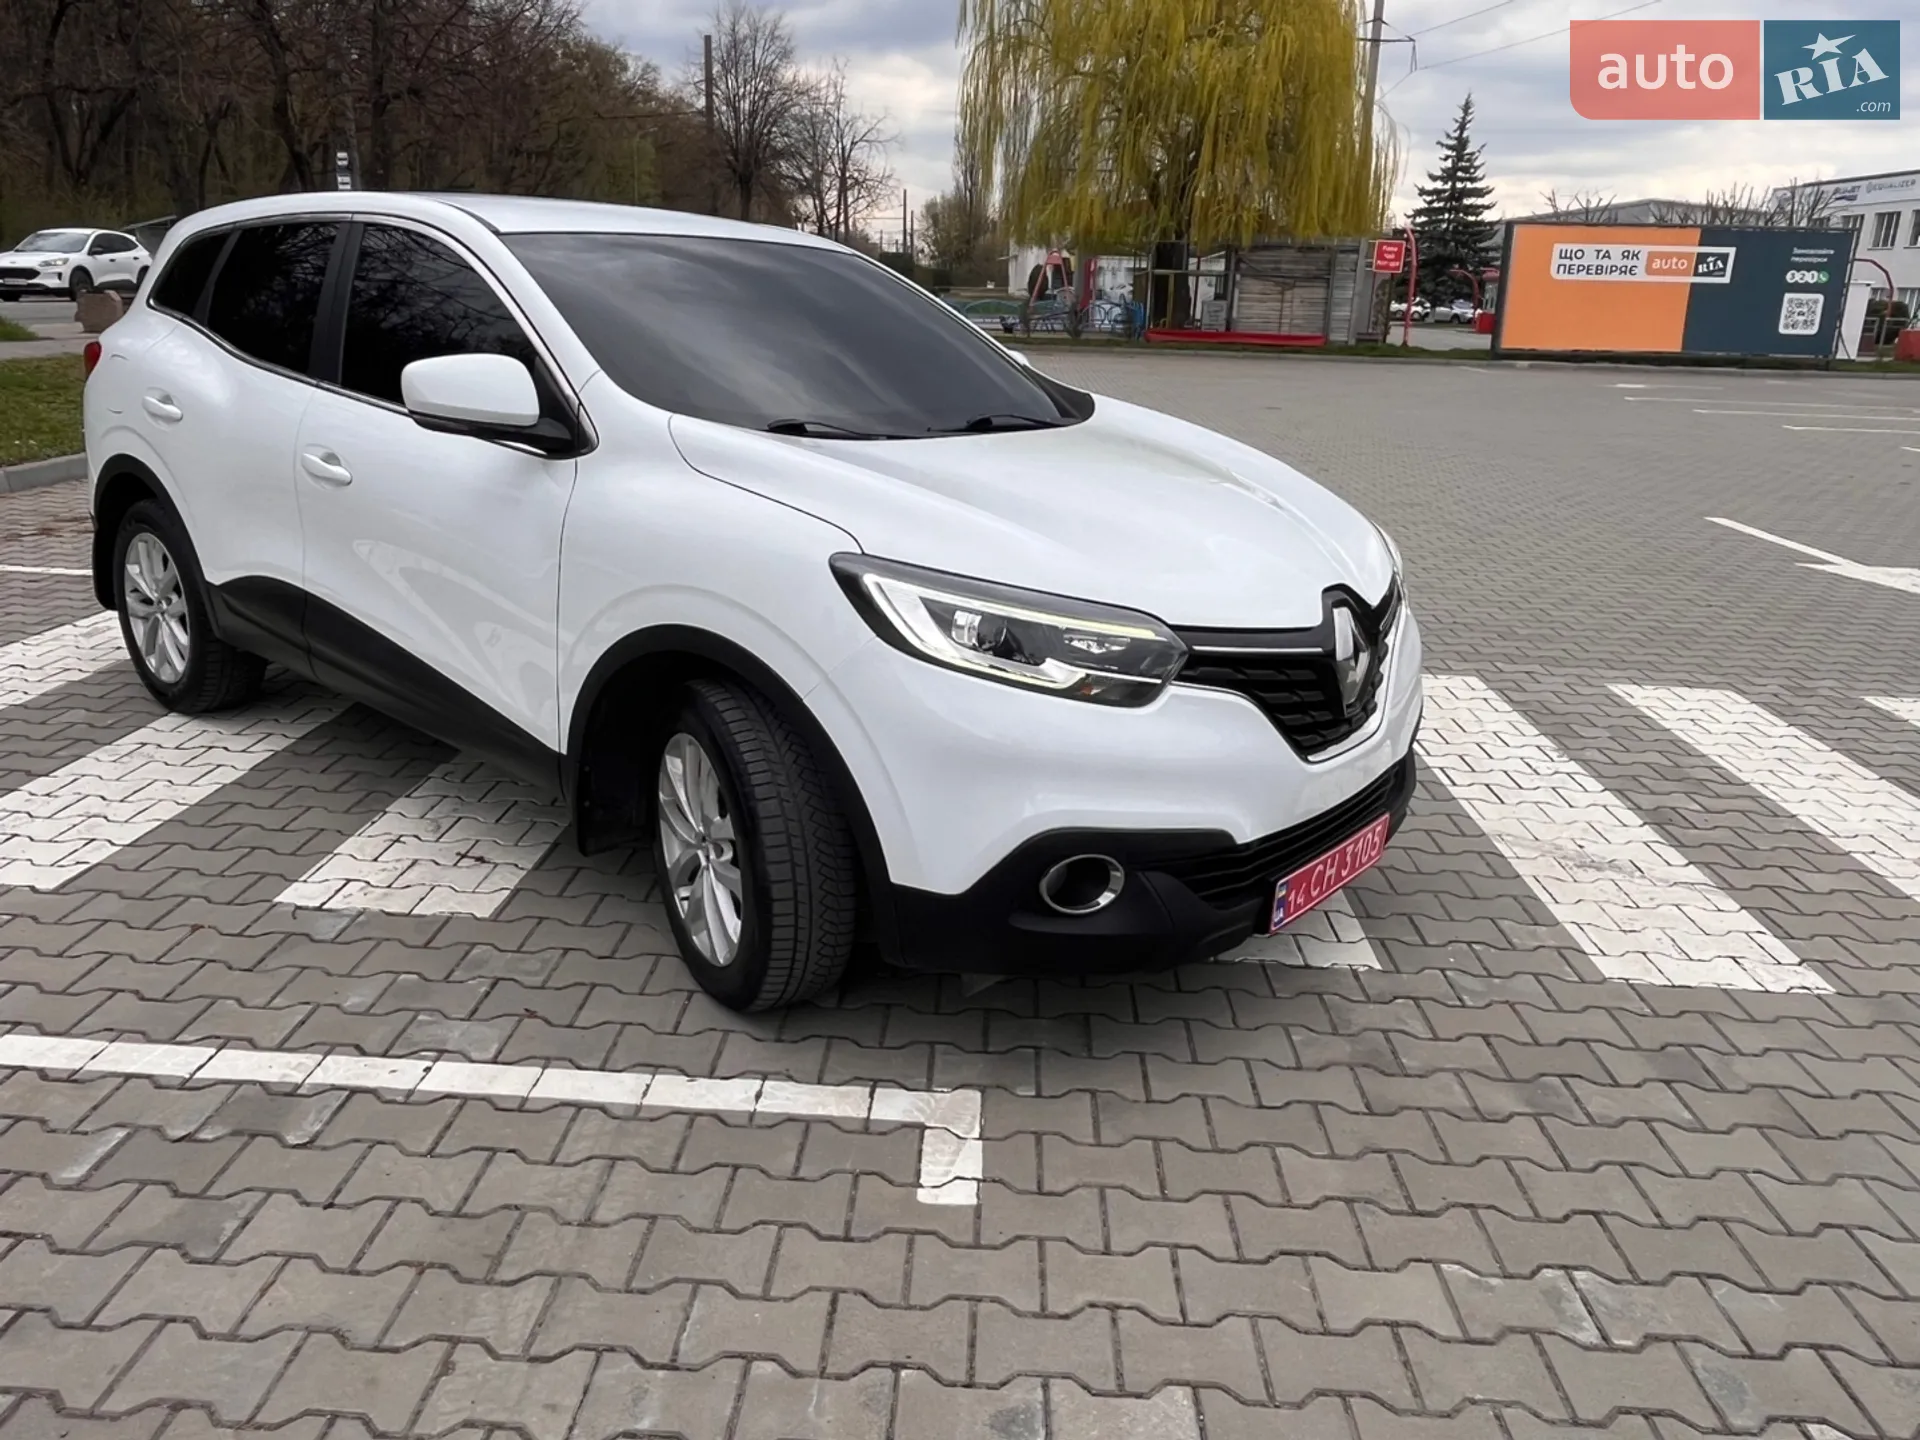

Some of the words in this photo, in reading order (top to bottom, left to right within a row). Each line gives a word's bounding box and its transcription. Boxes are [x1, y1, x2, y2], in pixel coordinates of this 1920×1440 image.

[1559, 248, 1585, 261] ЩО
[1594, 249, 1612, 260] ТА
[1621, 249, 1641, 261] ЯК
[1556, 264, 1639, 276] ПЕРЕВІРЯЄ
[1652, 256, 1688, 269] auto
[1697, 259, 1724, 273] RIA
[1288, 882, 1307, 913] 14
[1311, 853, 1340, 898] CH
[1341, 825, 1383, 877] 3105
